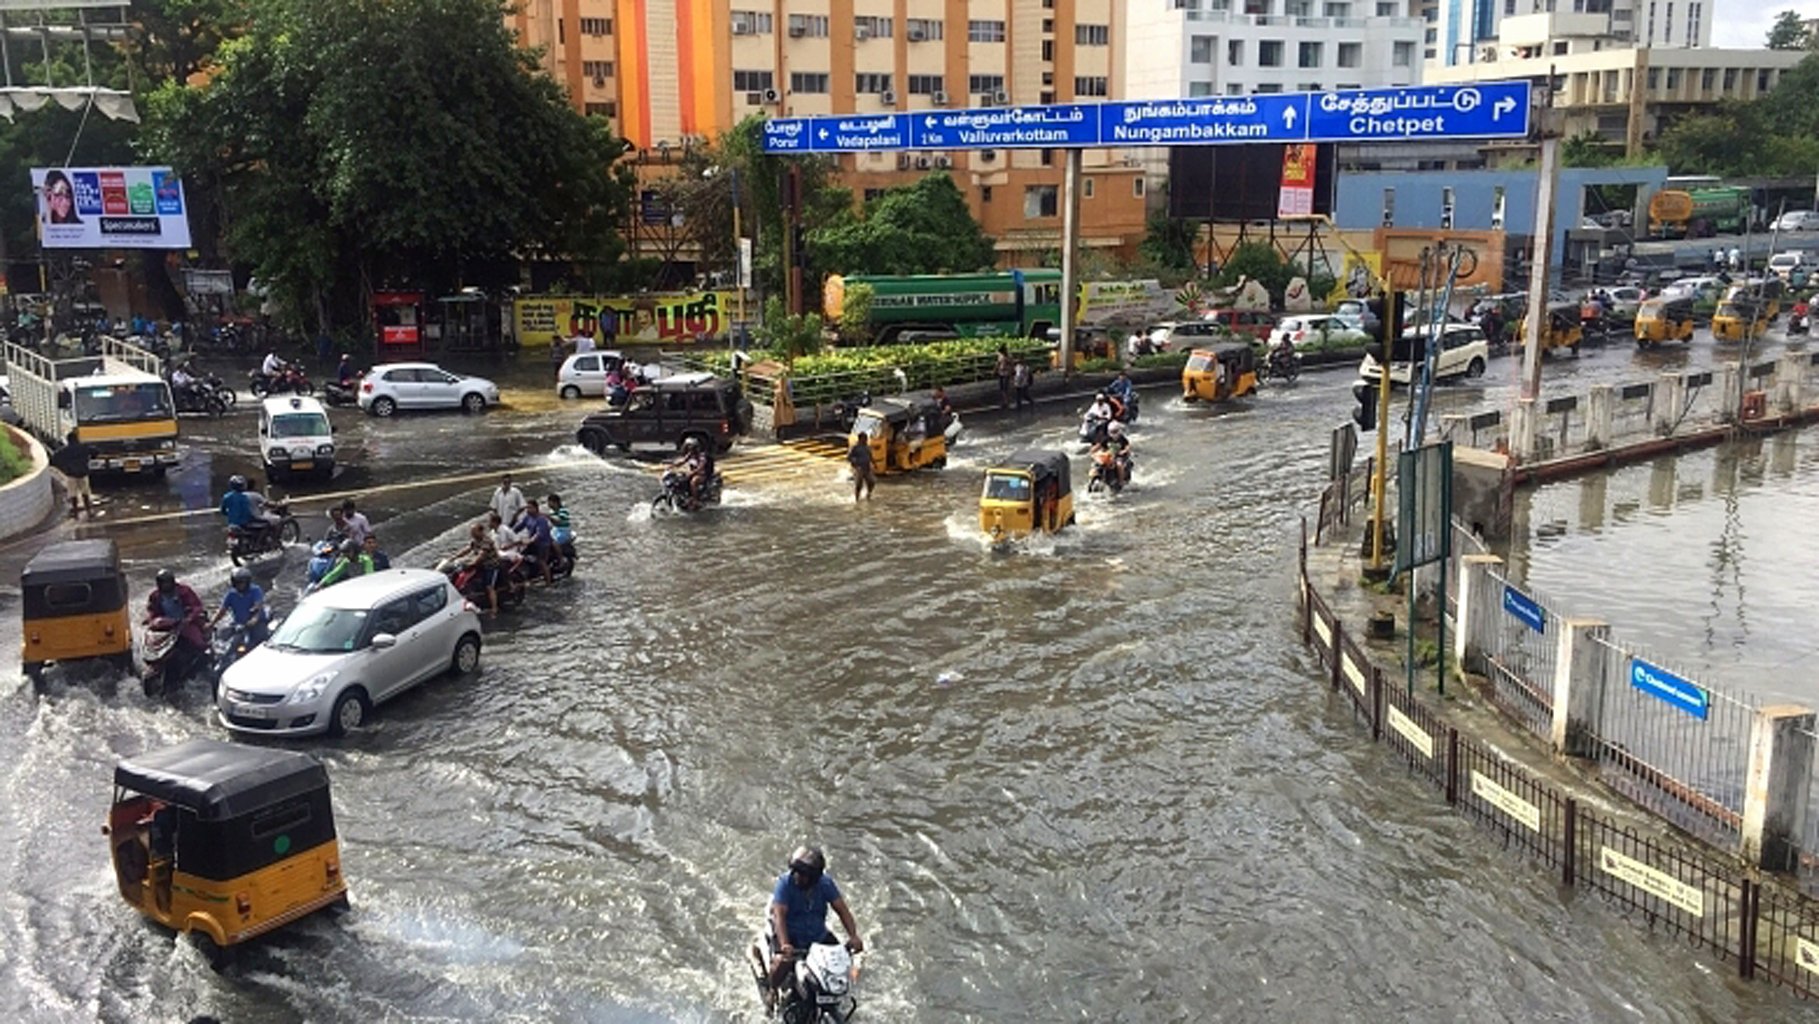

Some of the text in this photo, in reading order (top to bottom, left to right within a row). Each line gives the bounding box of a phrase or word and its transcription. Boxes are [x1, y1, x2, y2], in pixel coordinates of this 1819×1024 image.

[1123, 98, 1257, 123] நுங்கம்பாக்கம்
[1320, 88, 1481, 115] சேத்துப்பட்டு
[958, 128, 1070, 143] Valluvarkottam
[1113, 122, 1269, 142] Nungambakkam
[1349, 115, 1445, 136] Chetpet
[768, 136, 799, 148] Porur
[835, 133, 902, 149] Vadapalani
